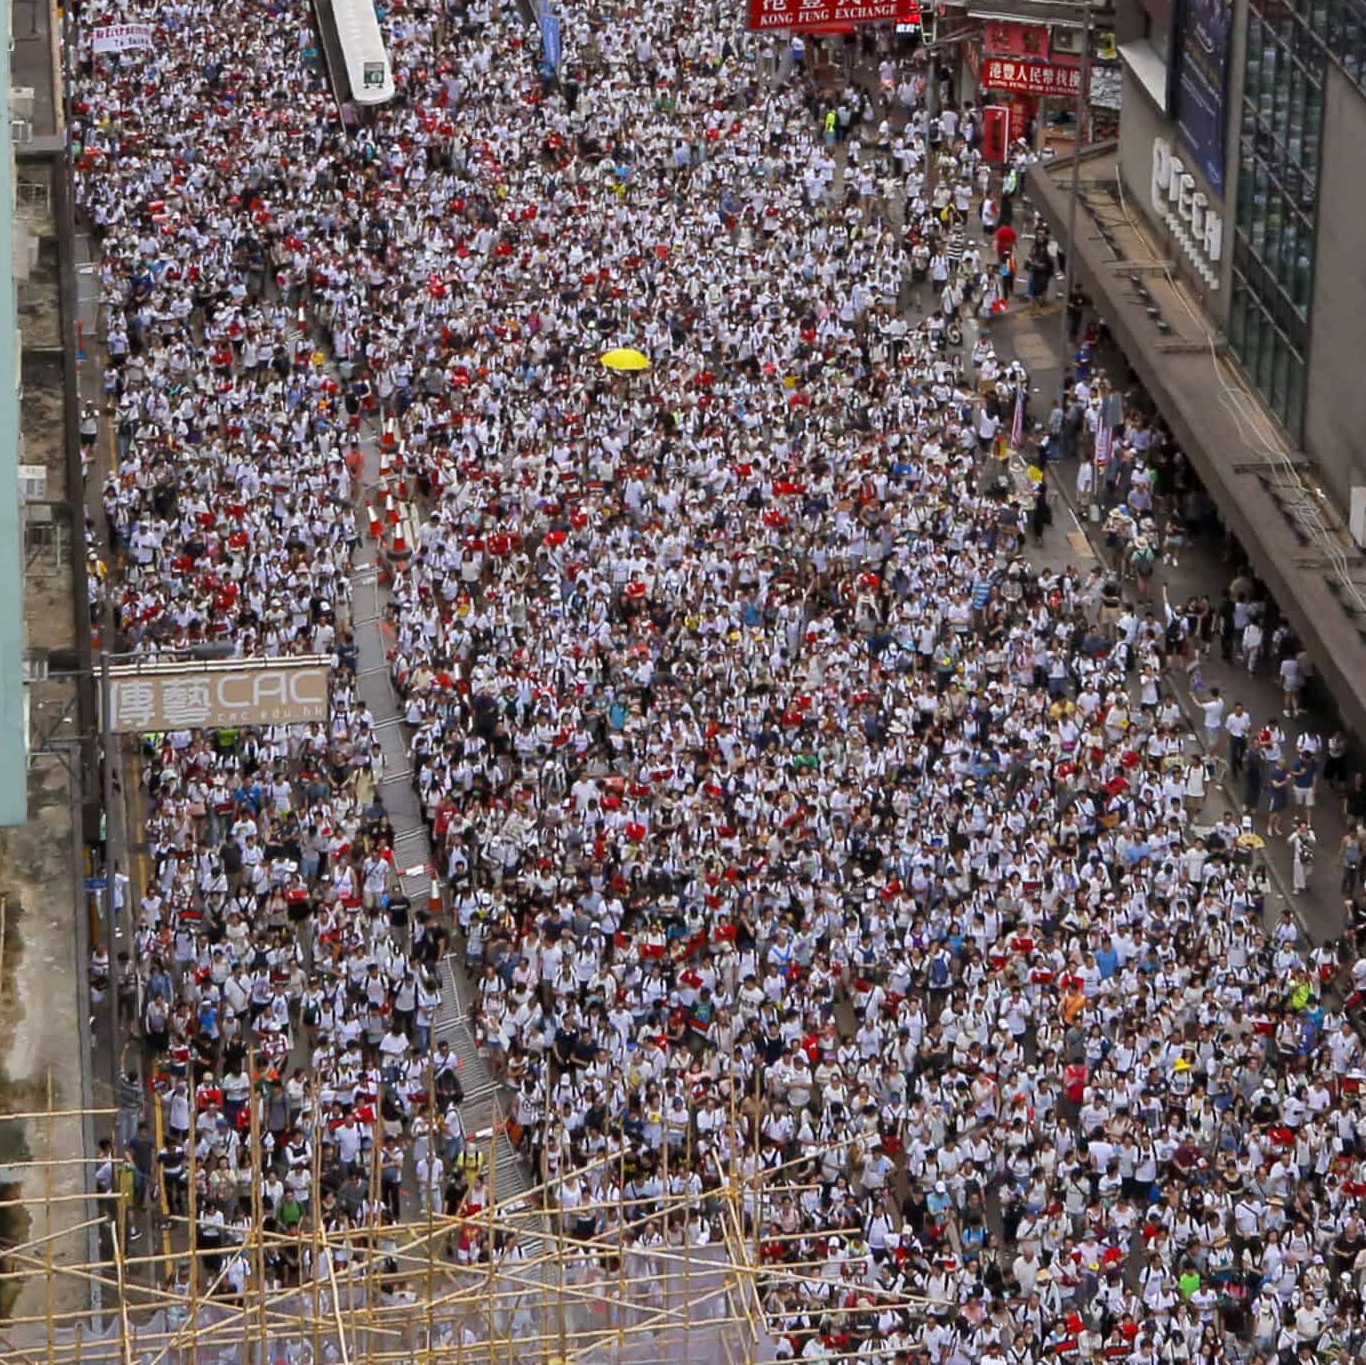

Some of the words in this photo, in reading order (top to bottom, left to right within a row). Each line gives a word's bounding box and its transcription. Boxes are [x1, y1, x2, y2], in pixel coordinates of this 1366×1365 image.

[760, 12, 793, 26] KONG
[798, 9, 829, 22] FUNG
[835, 4, 898, 19] EXCHANGE
[217, 670, 323, 708] CAC
